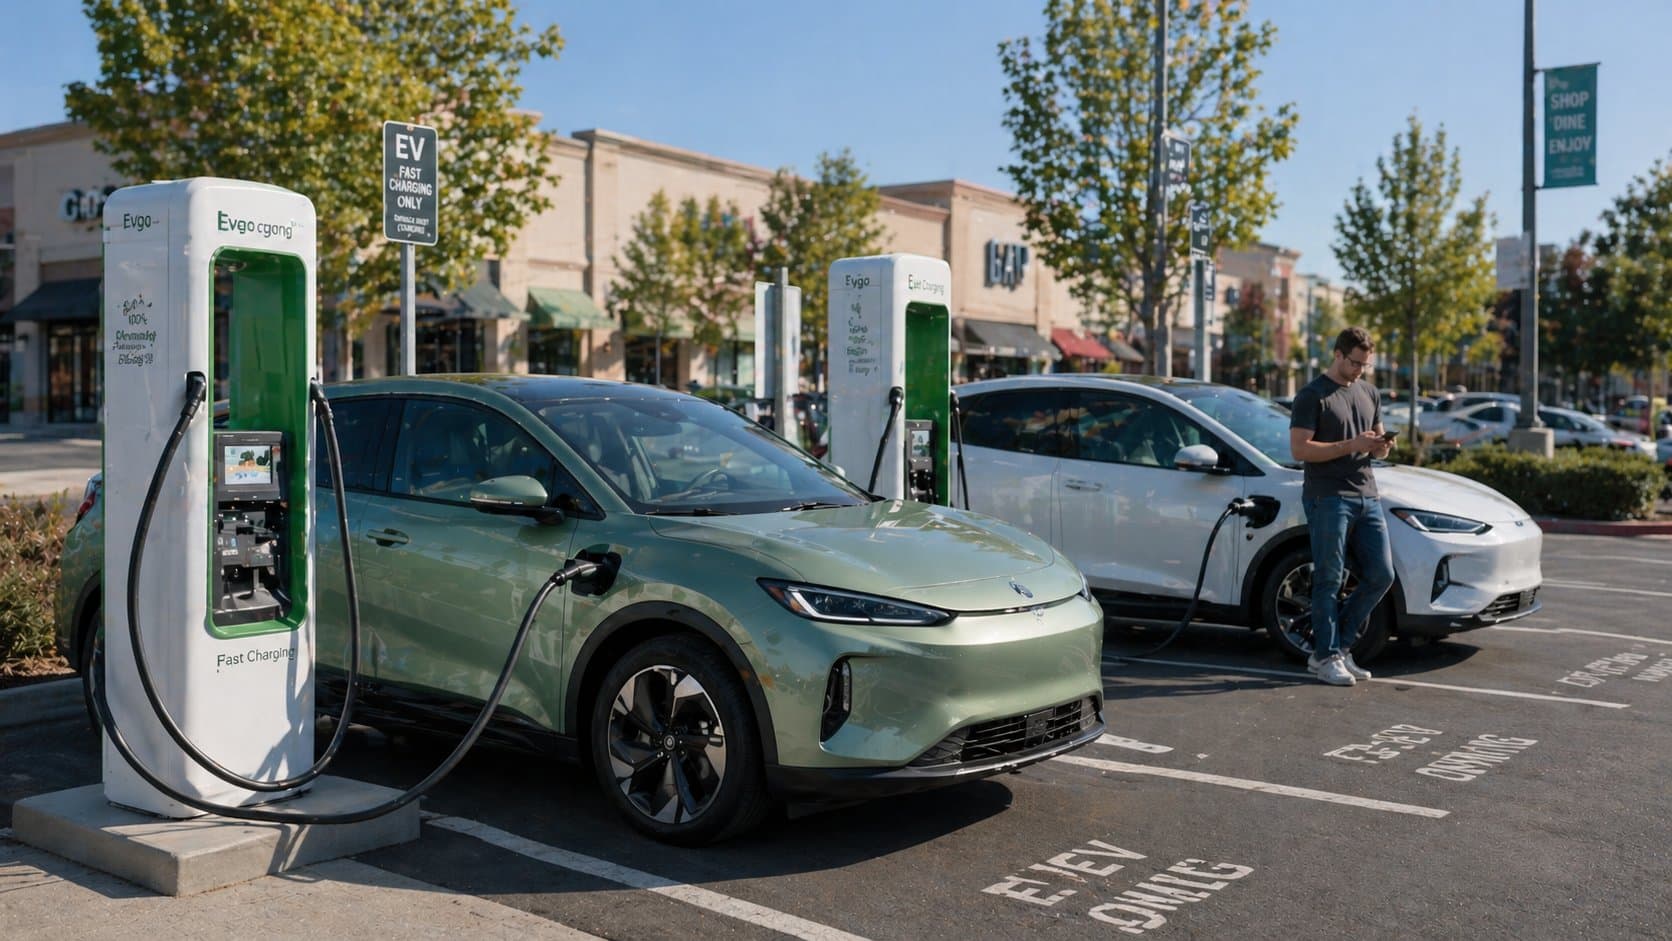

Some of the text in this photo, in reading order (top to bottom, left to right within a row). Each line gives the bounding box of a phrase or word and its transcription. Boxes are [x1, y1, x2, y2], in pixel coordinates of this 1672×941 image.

[1551, 91, 1589, 109] SHOP
[1553, 113, 1586, 131] DINE
[396, 133, 425, 161] EV
[1549, 136, 1592, 154] ENJOY
[399, 165, 422, 180] FAST
[389, 178, 433, 196] CHARGING
[397, 195, 423, 210] ONLY
[123, 213, 152, 232] Evgo
[217, 210, 255, 235] Evgo
[217, 647, 295, 667] Fast Charging
